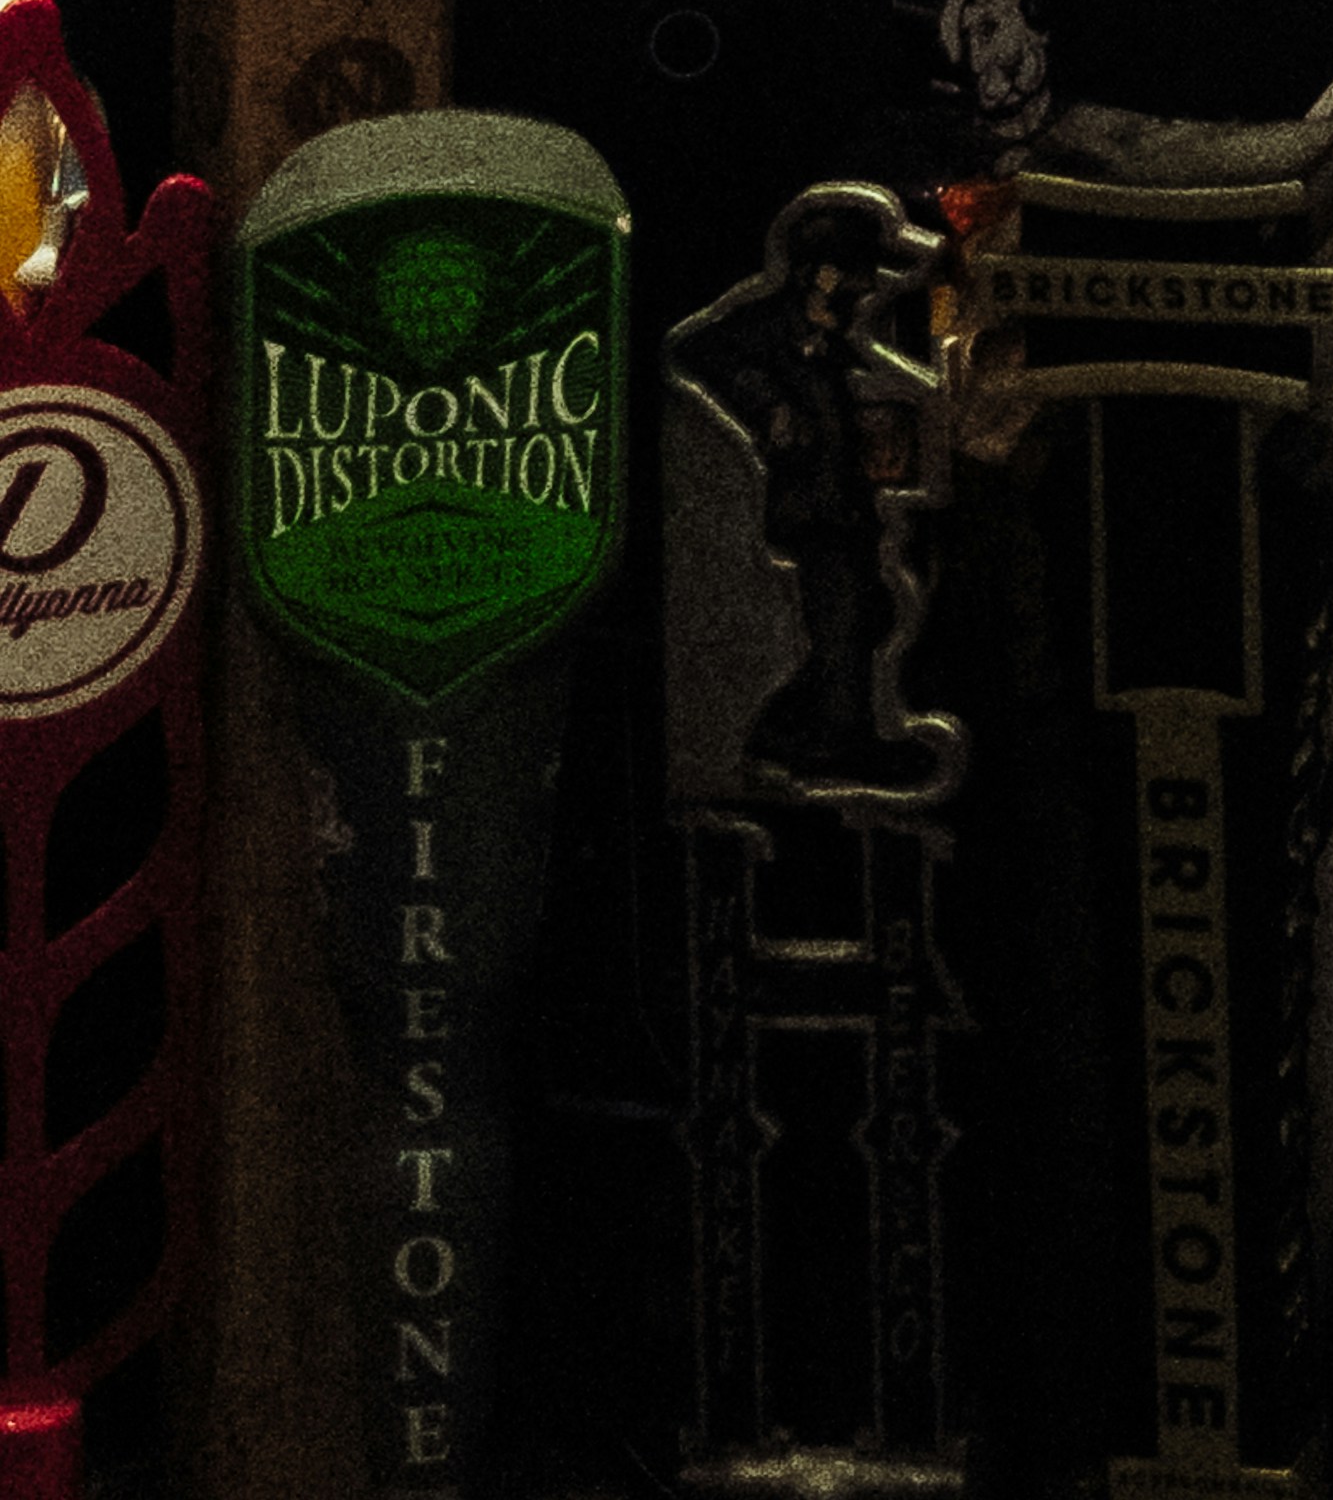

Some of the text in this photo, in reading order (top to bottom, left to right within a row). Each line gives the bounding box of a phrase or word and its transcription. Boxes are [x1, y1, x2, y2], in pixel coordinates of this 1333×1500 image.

[261, 330, 602, 443] LUPONIC
[266, 427, 599, 540] DISTORTION
[394, 736, 456, 1467] FIRESTONE
[1146, 777, 1226, 1434] BRICKSTONE
